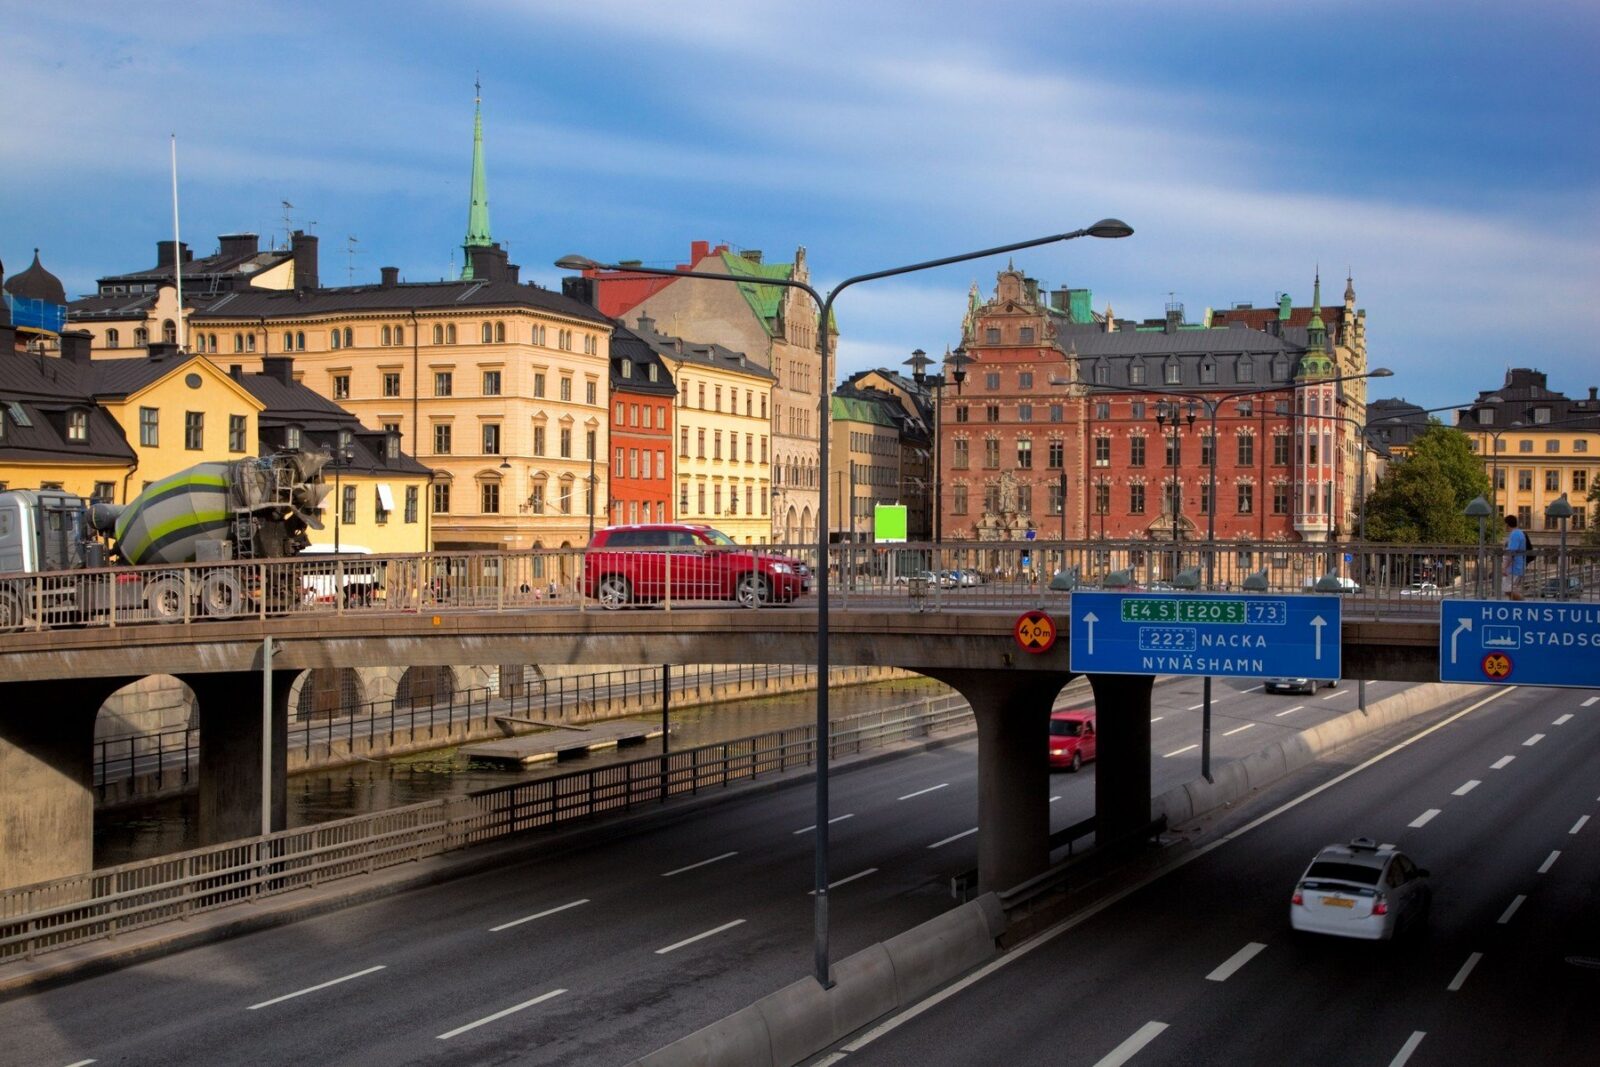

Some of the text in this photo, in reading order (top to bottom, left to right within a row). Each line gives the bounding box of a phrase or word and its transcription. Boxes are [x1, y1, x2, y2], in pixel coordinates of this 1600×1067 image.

[1131, 604, 1169, 617] E4 S
[1187, 605, 1236, 619] E20 S
[1255, 606, 1277, 619] 73
[1151, 632, 1185, 646] 222
[1201, 634, 1267, 648] NACKA
[1524, 631, 1600, 647] STADSG
[1142, 654, 1263, 672] NYNÄSHAMN
